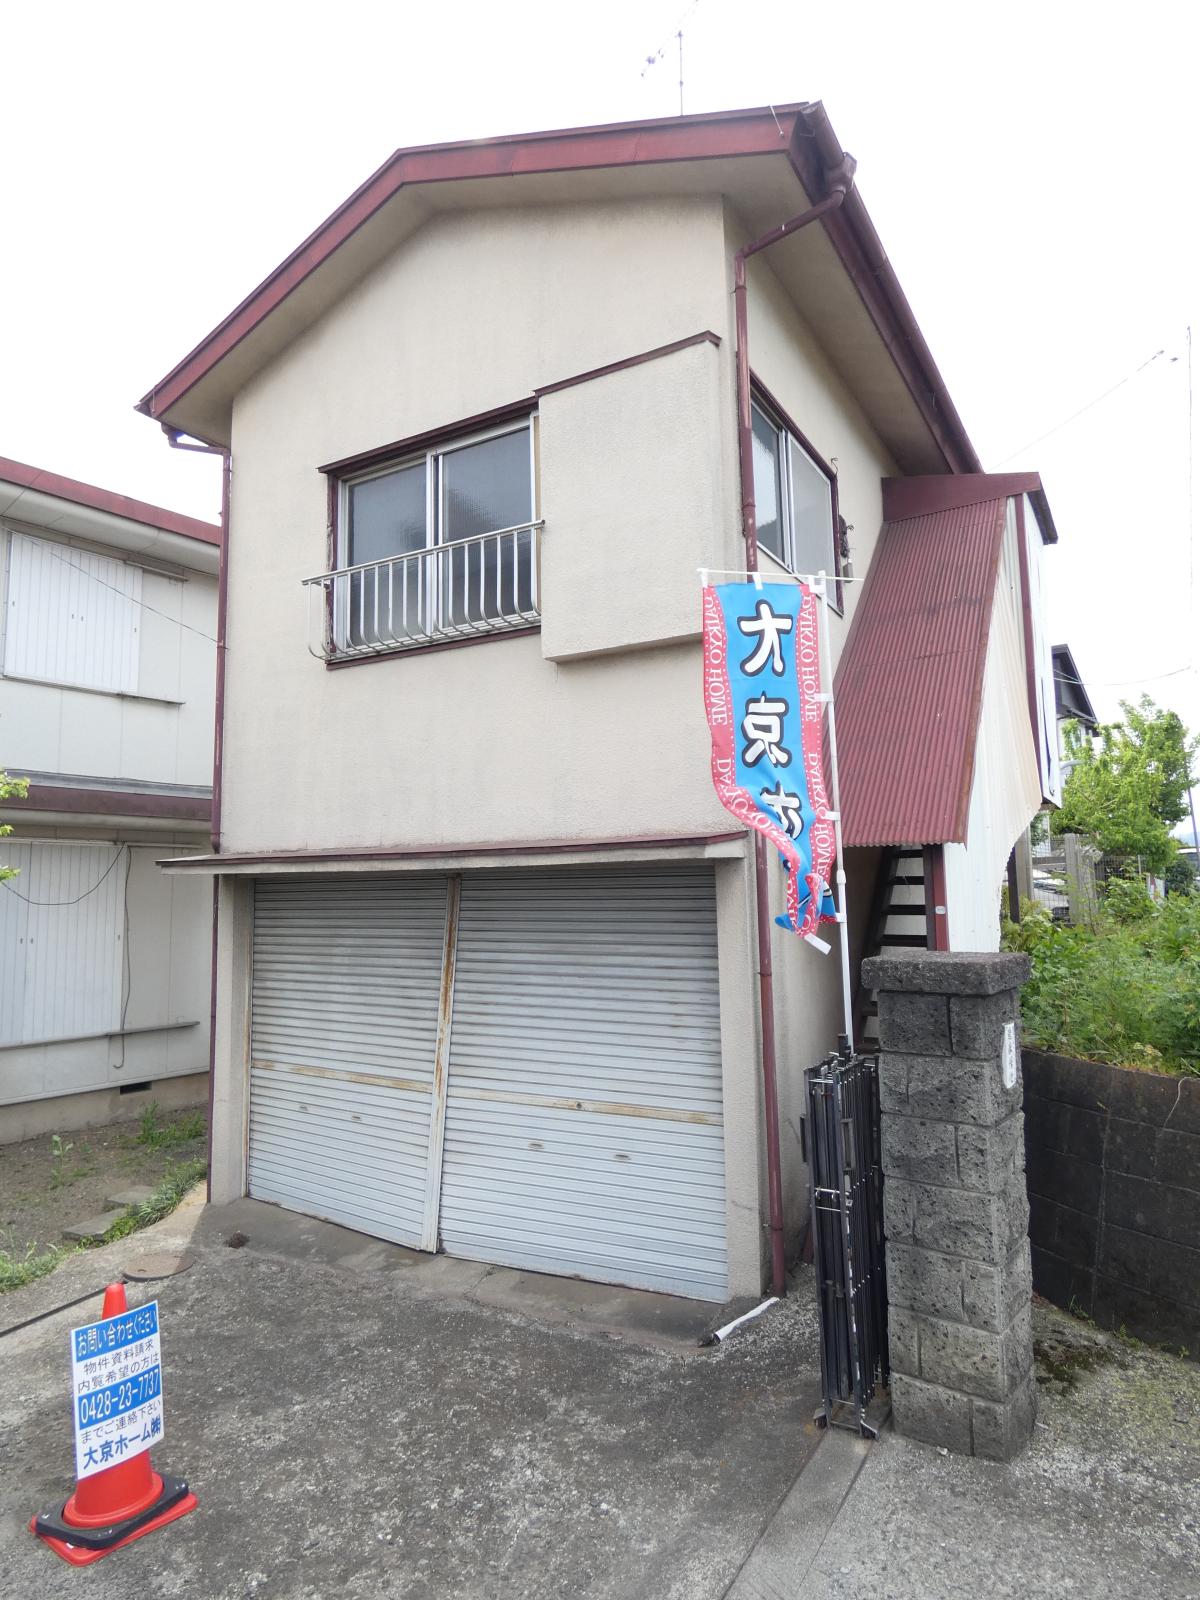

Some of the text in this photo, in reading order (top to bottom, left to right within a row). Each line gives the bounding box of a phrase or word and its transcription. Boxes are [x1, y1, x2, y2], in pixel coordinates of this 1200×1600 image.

[77, 1309, 158, 1357] お問い合わせください
[78, 1352, 160, 1395] 内覧希望の方は
[83, 1338, 154, 1376] 物件資料請求
[80, 1368, 160, 1424] 0428-23-7737
[81, 1399, 162, 1444] までご連絡下さい
